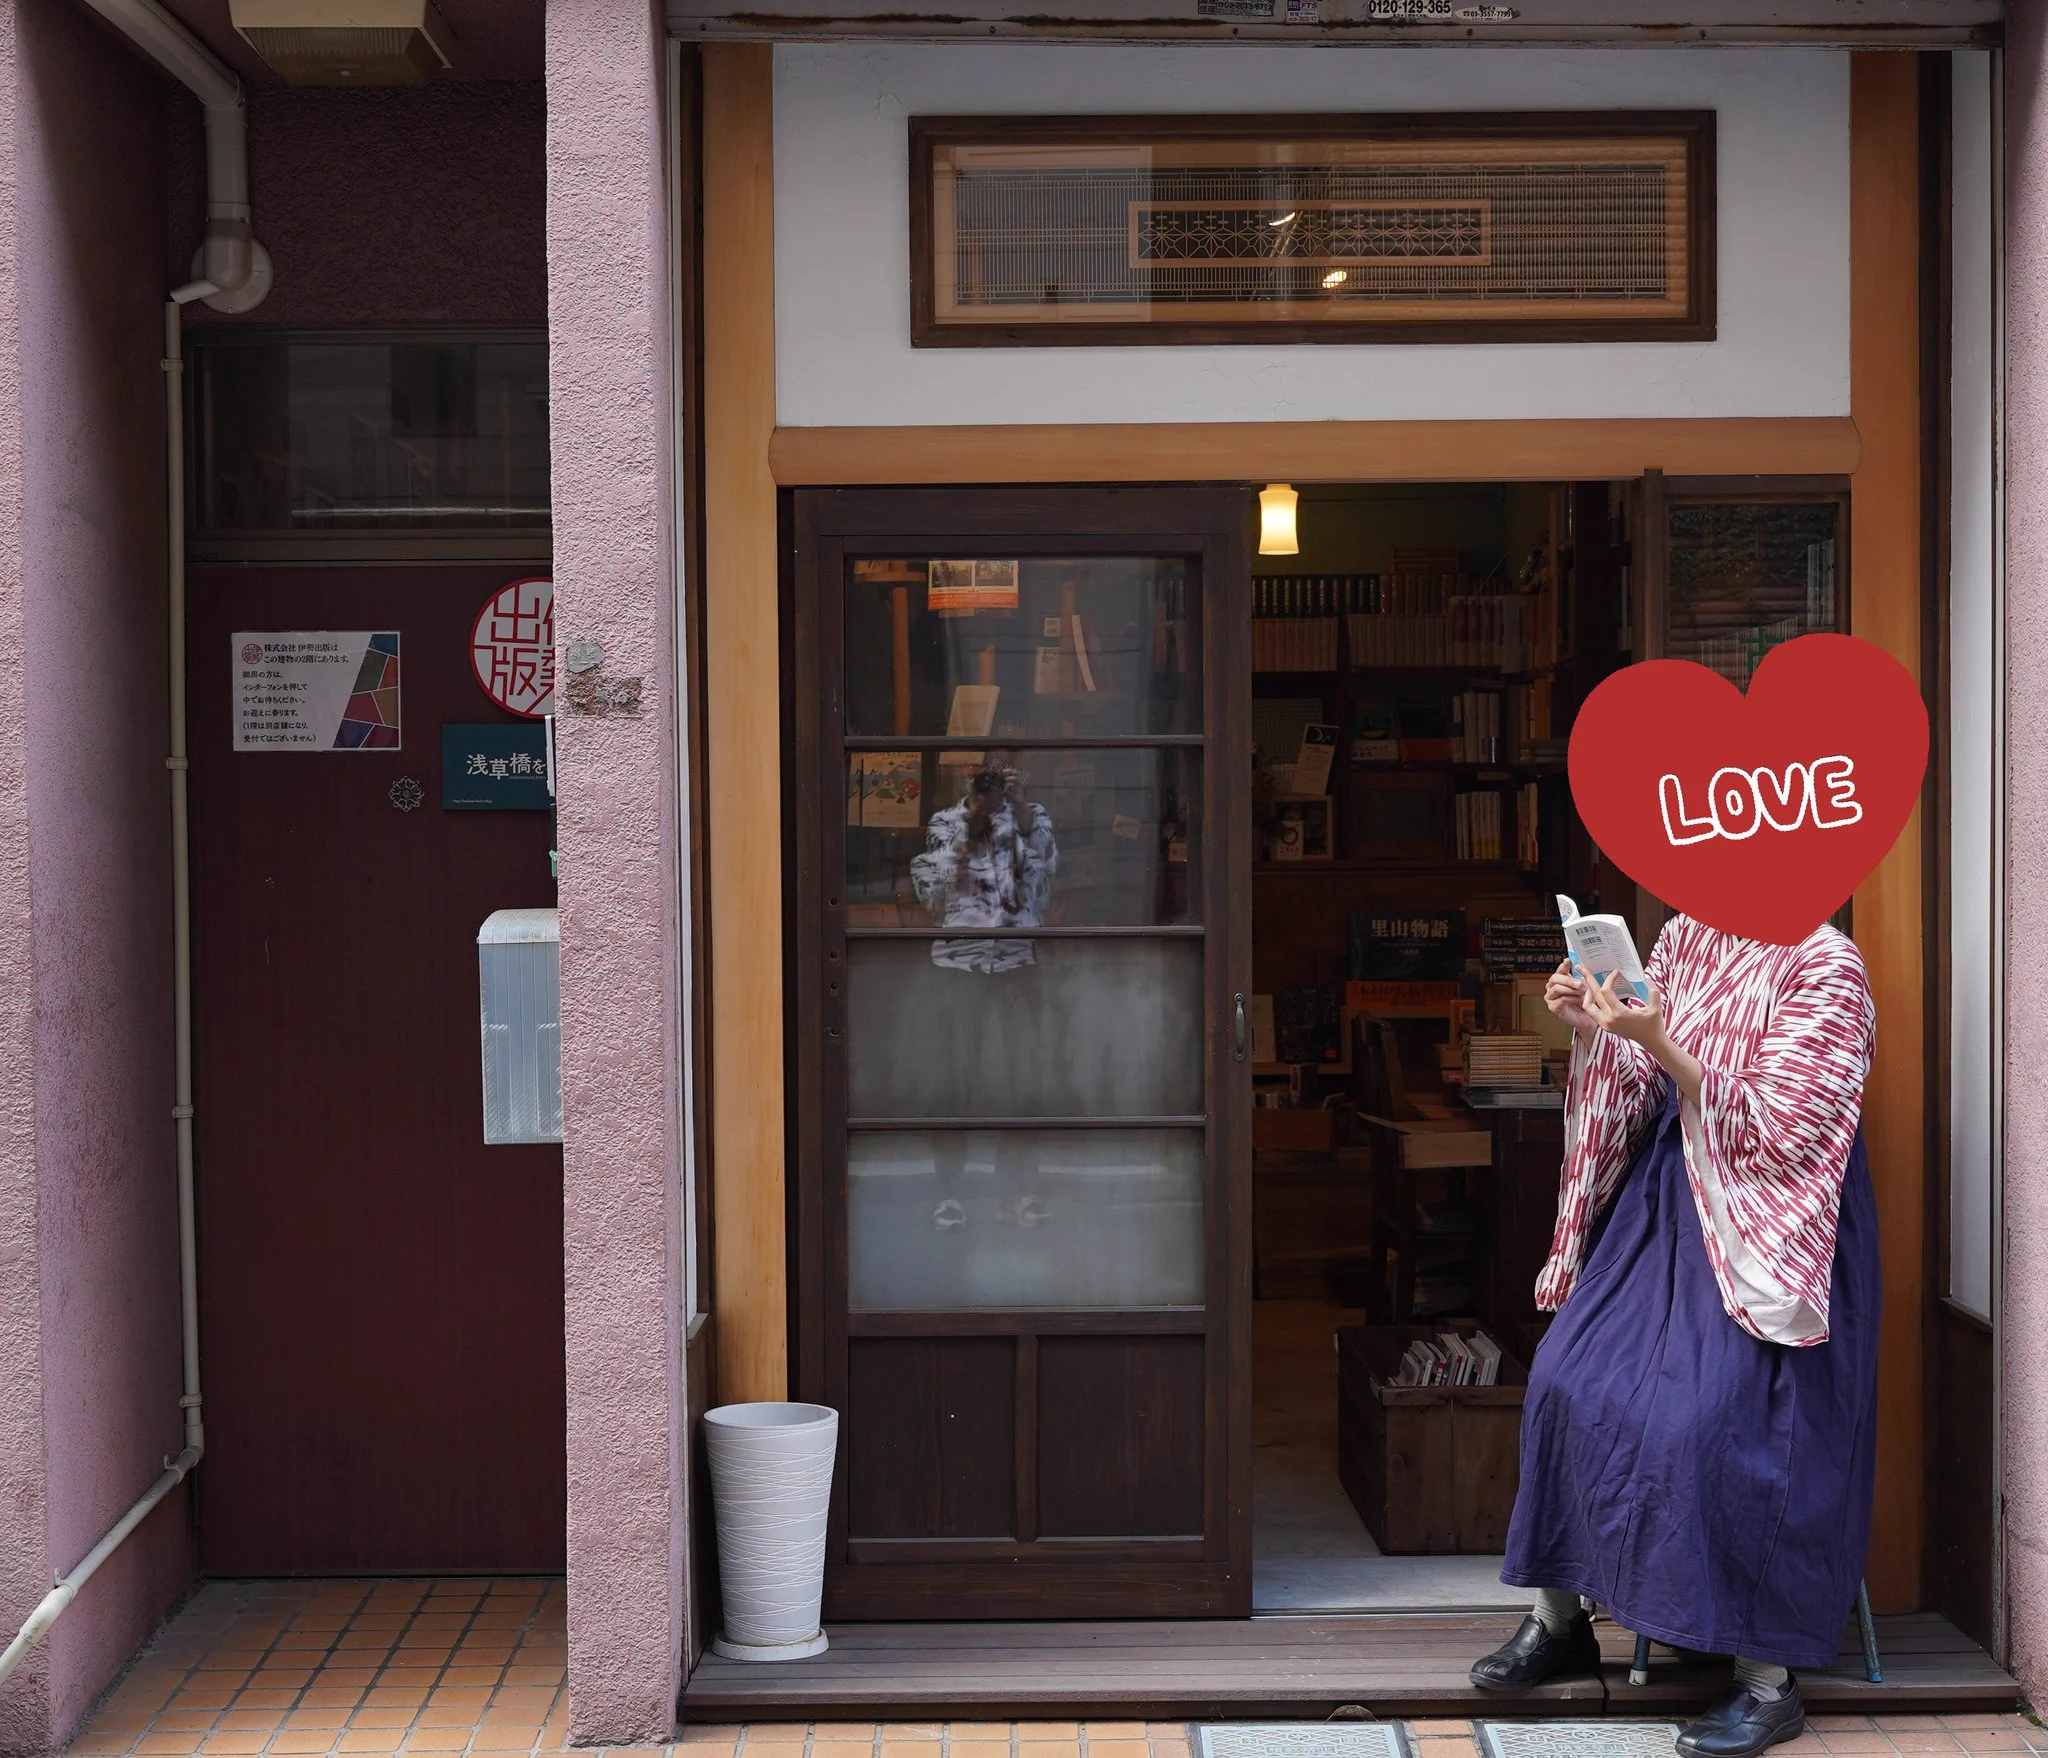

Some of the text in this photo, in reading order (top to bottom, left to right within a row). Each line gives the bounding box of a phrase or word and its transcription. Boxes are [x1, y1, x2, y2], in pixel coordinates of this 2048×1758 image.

[1368, 0, 1451, 13] 0120-129-365
[263, 643, 338, 652] 株式会社 伊勢出版は
[263, 655, 349, 664] この建物の2階にあります。
[243, 683, 308, 691] インターフォンを押して
[243, 696, 307, 704] 中でお待ちください。
[243, 709, 299, 717] お迎えに参ります。
[466, 752, 546, 780] 浅草橋を
[1371, 919, 1449, 938] 里山物語
